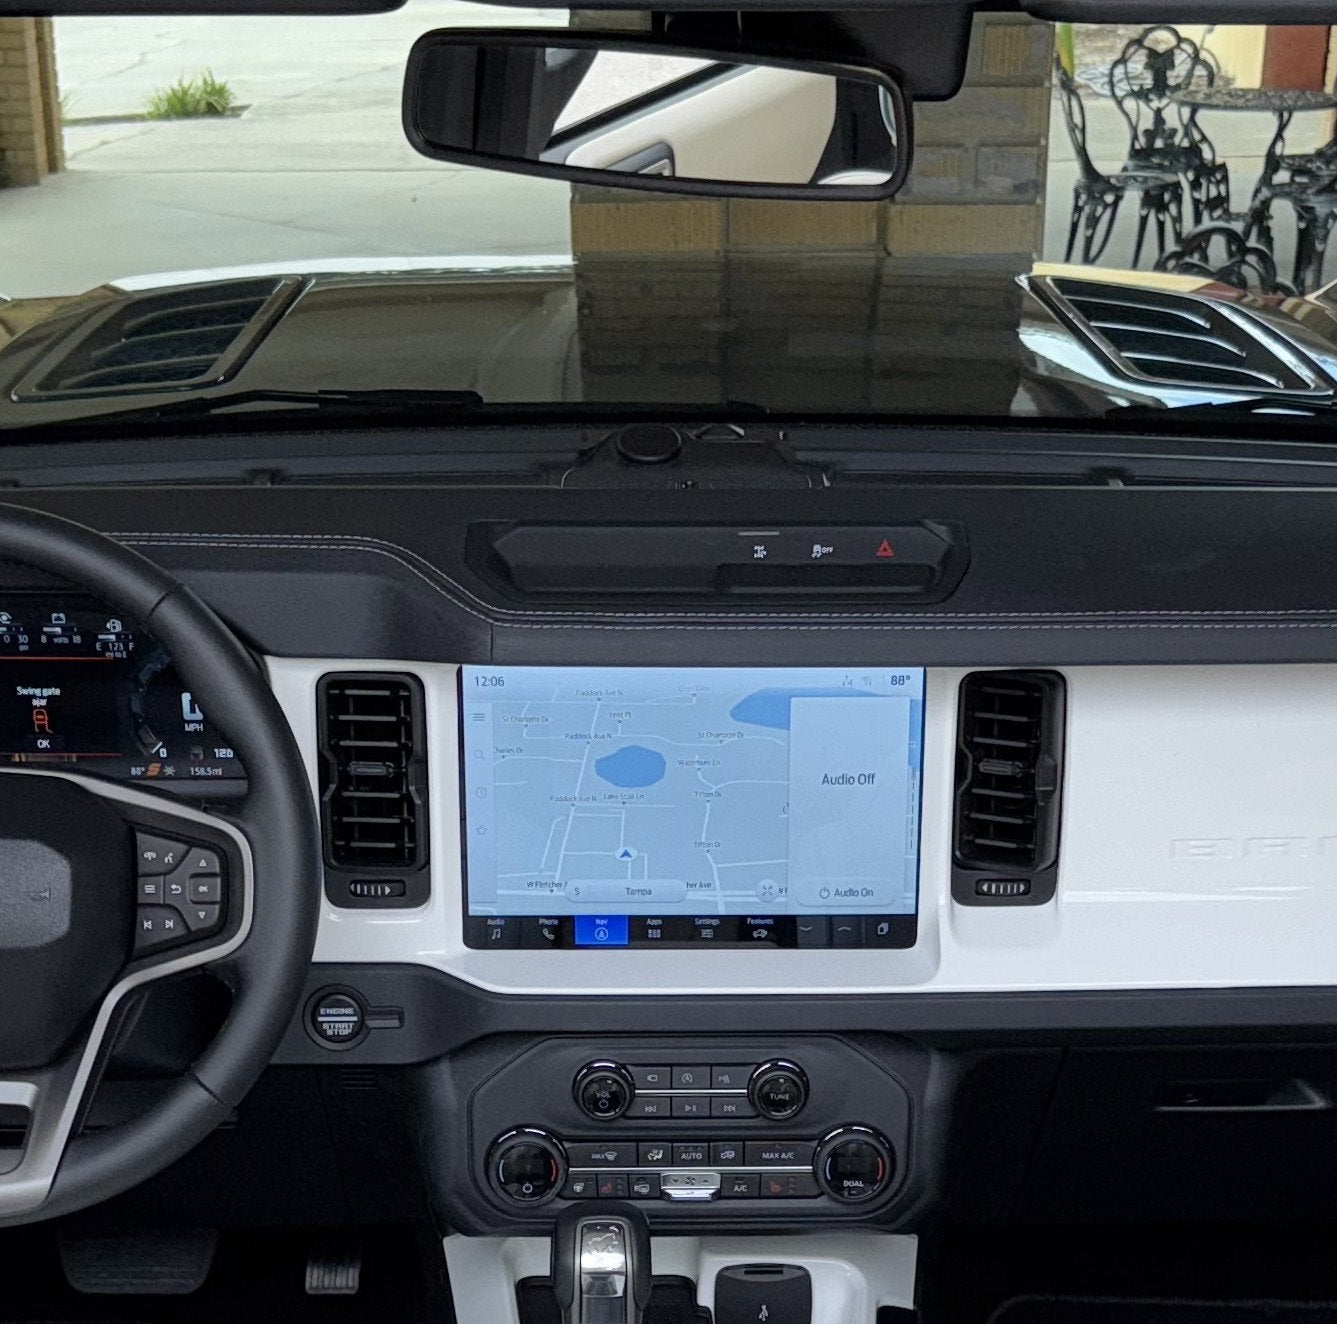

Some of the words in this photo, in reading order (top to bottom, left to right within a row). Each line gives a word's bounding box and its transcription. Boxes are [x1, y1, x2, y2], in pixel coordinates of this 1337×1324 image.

[474, 676, 505, 687] 12:06
[890, 675, 911, 686] 88°
[16, 686, 41, 697] Swing
[42, 687, 61, 697] gate
[184, 723, 204, 732] MPH
[37, 739, 51, 748] OK
[821, 773, 855, 785] Audio
[857, 772, 876, 785] Off
[625, 887, 653, 896] Tampa
[834, 888, 859, 897] Audio
[860, 888, 874, 897] On
[319, 1007, 354, 1015] ENGINE
[322, 1022, 354, 1030] START
